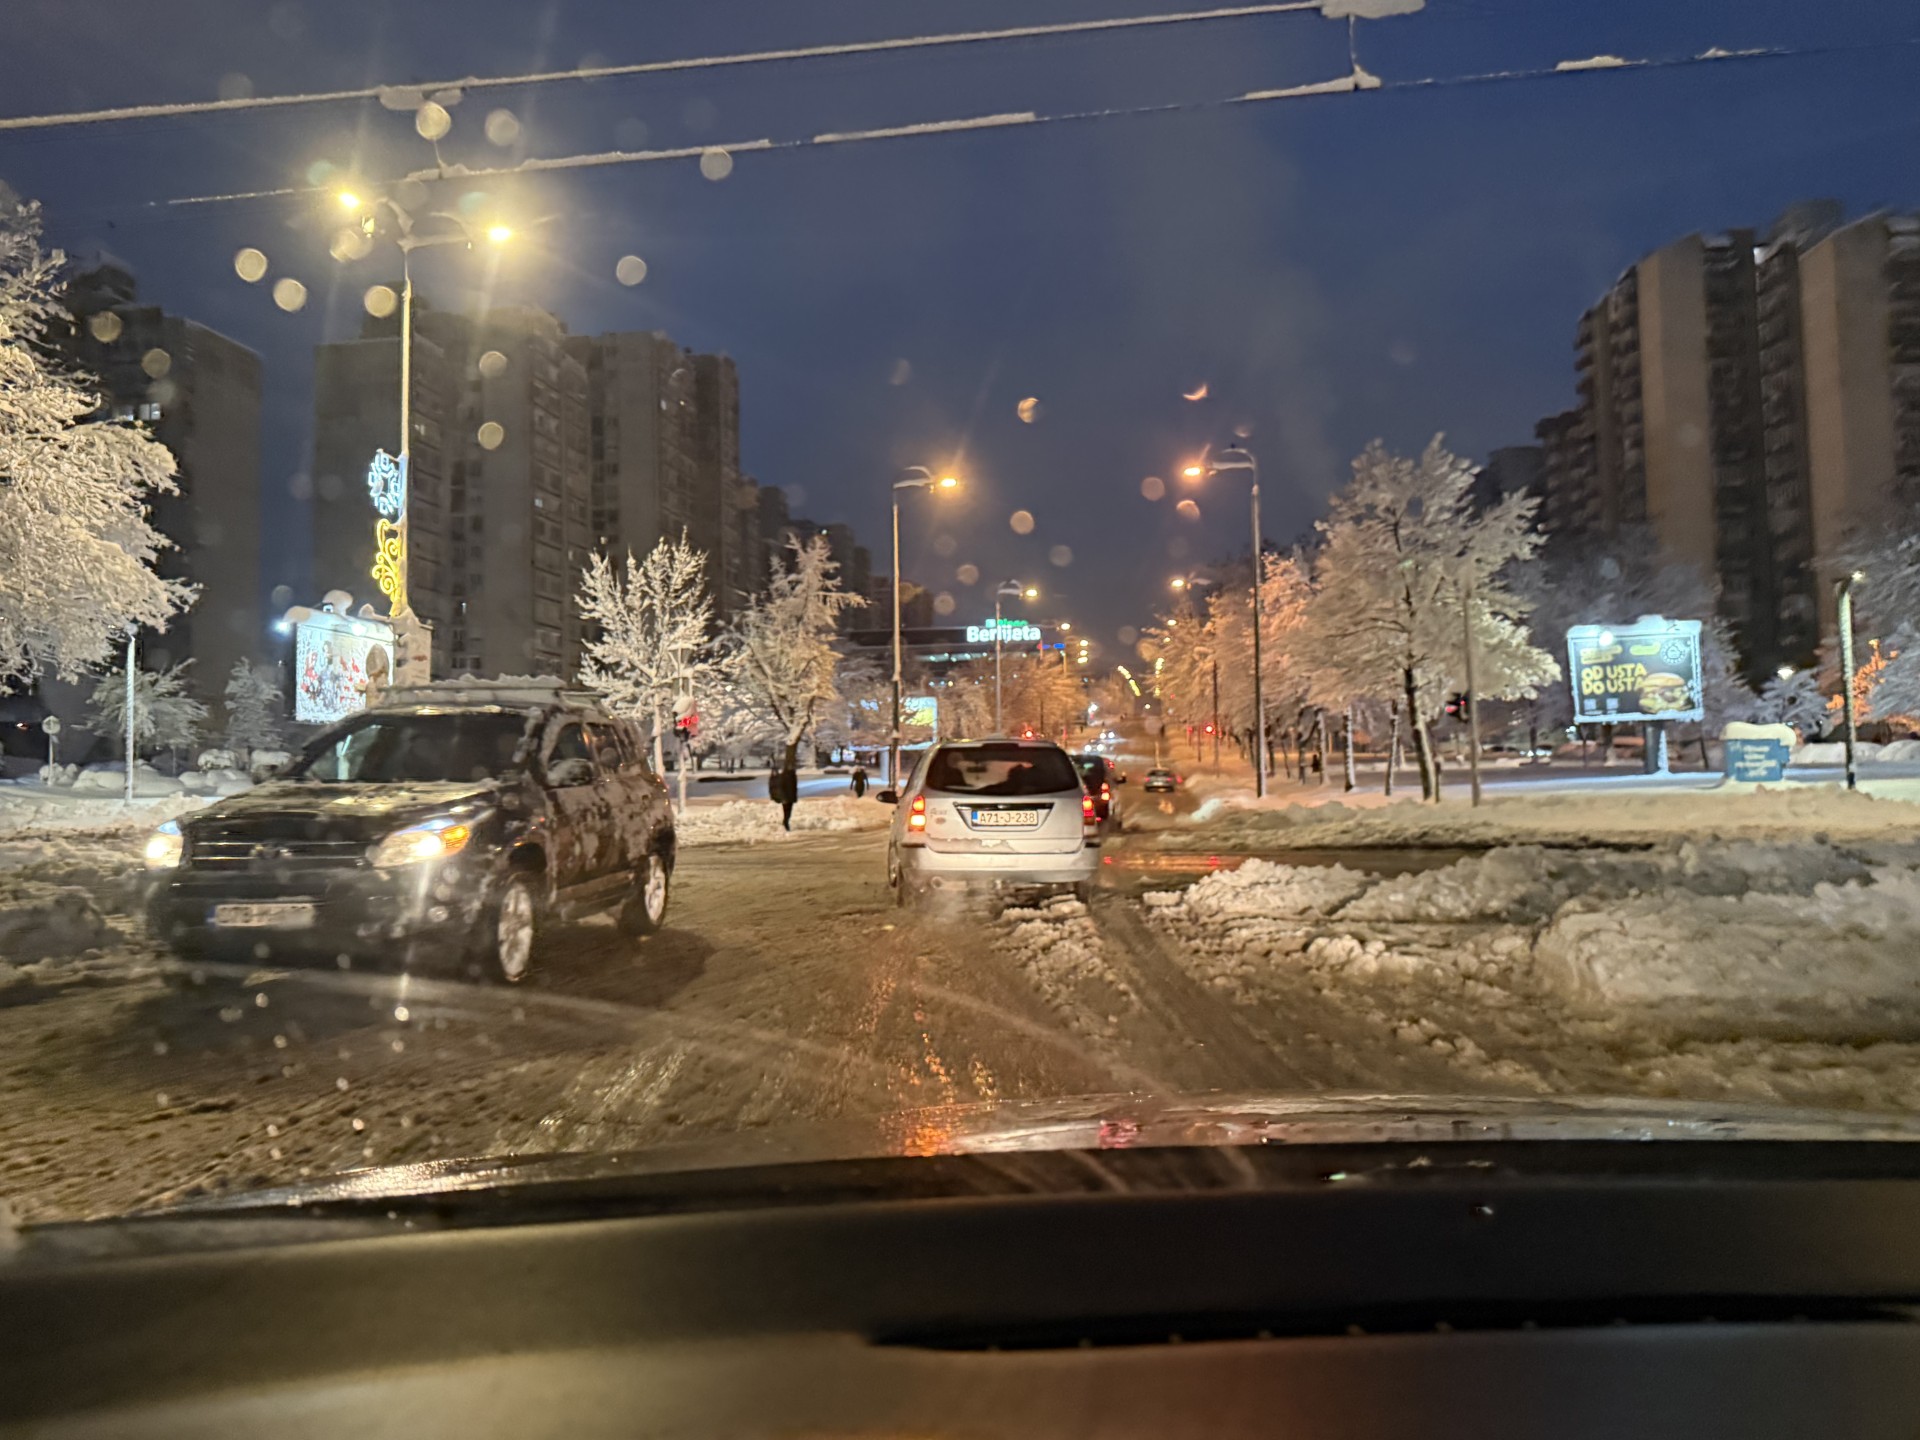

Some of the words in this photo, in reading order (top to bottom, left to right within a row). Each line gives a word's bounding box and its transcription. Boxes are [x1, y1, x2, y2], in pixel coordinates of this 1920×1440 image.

[1581, 665, 1604, 680] OD
[1606, 663, 1647, 679] USTA
[1582, 680, 1605, 695] DO
[1606, 677, 1645, 693] USTA
[980, 812, 1036, 824] A71-J-238
